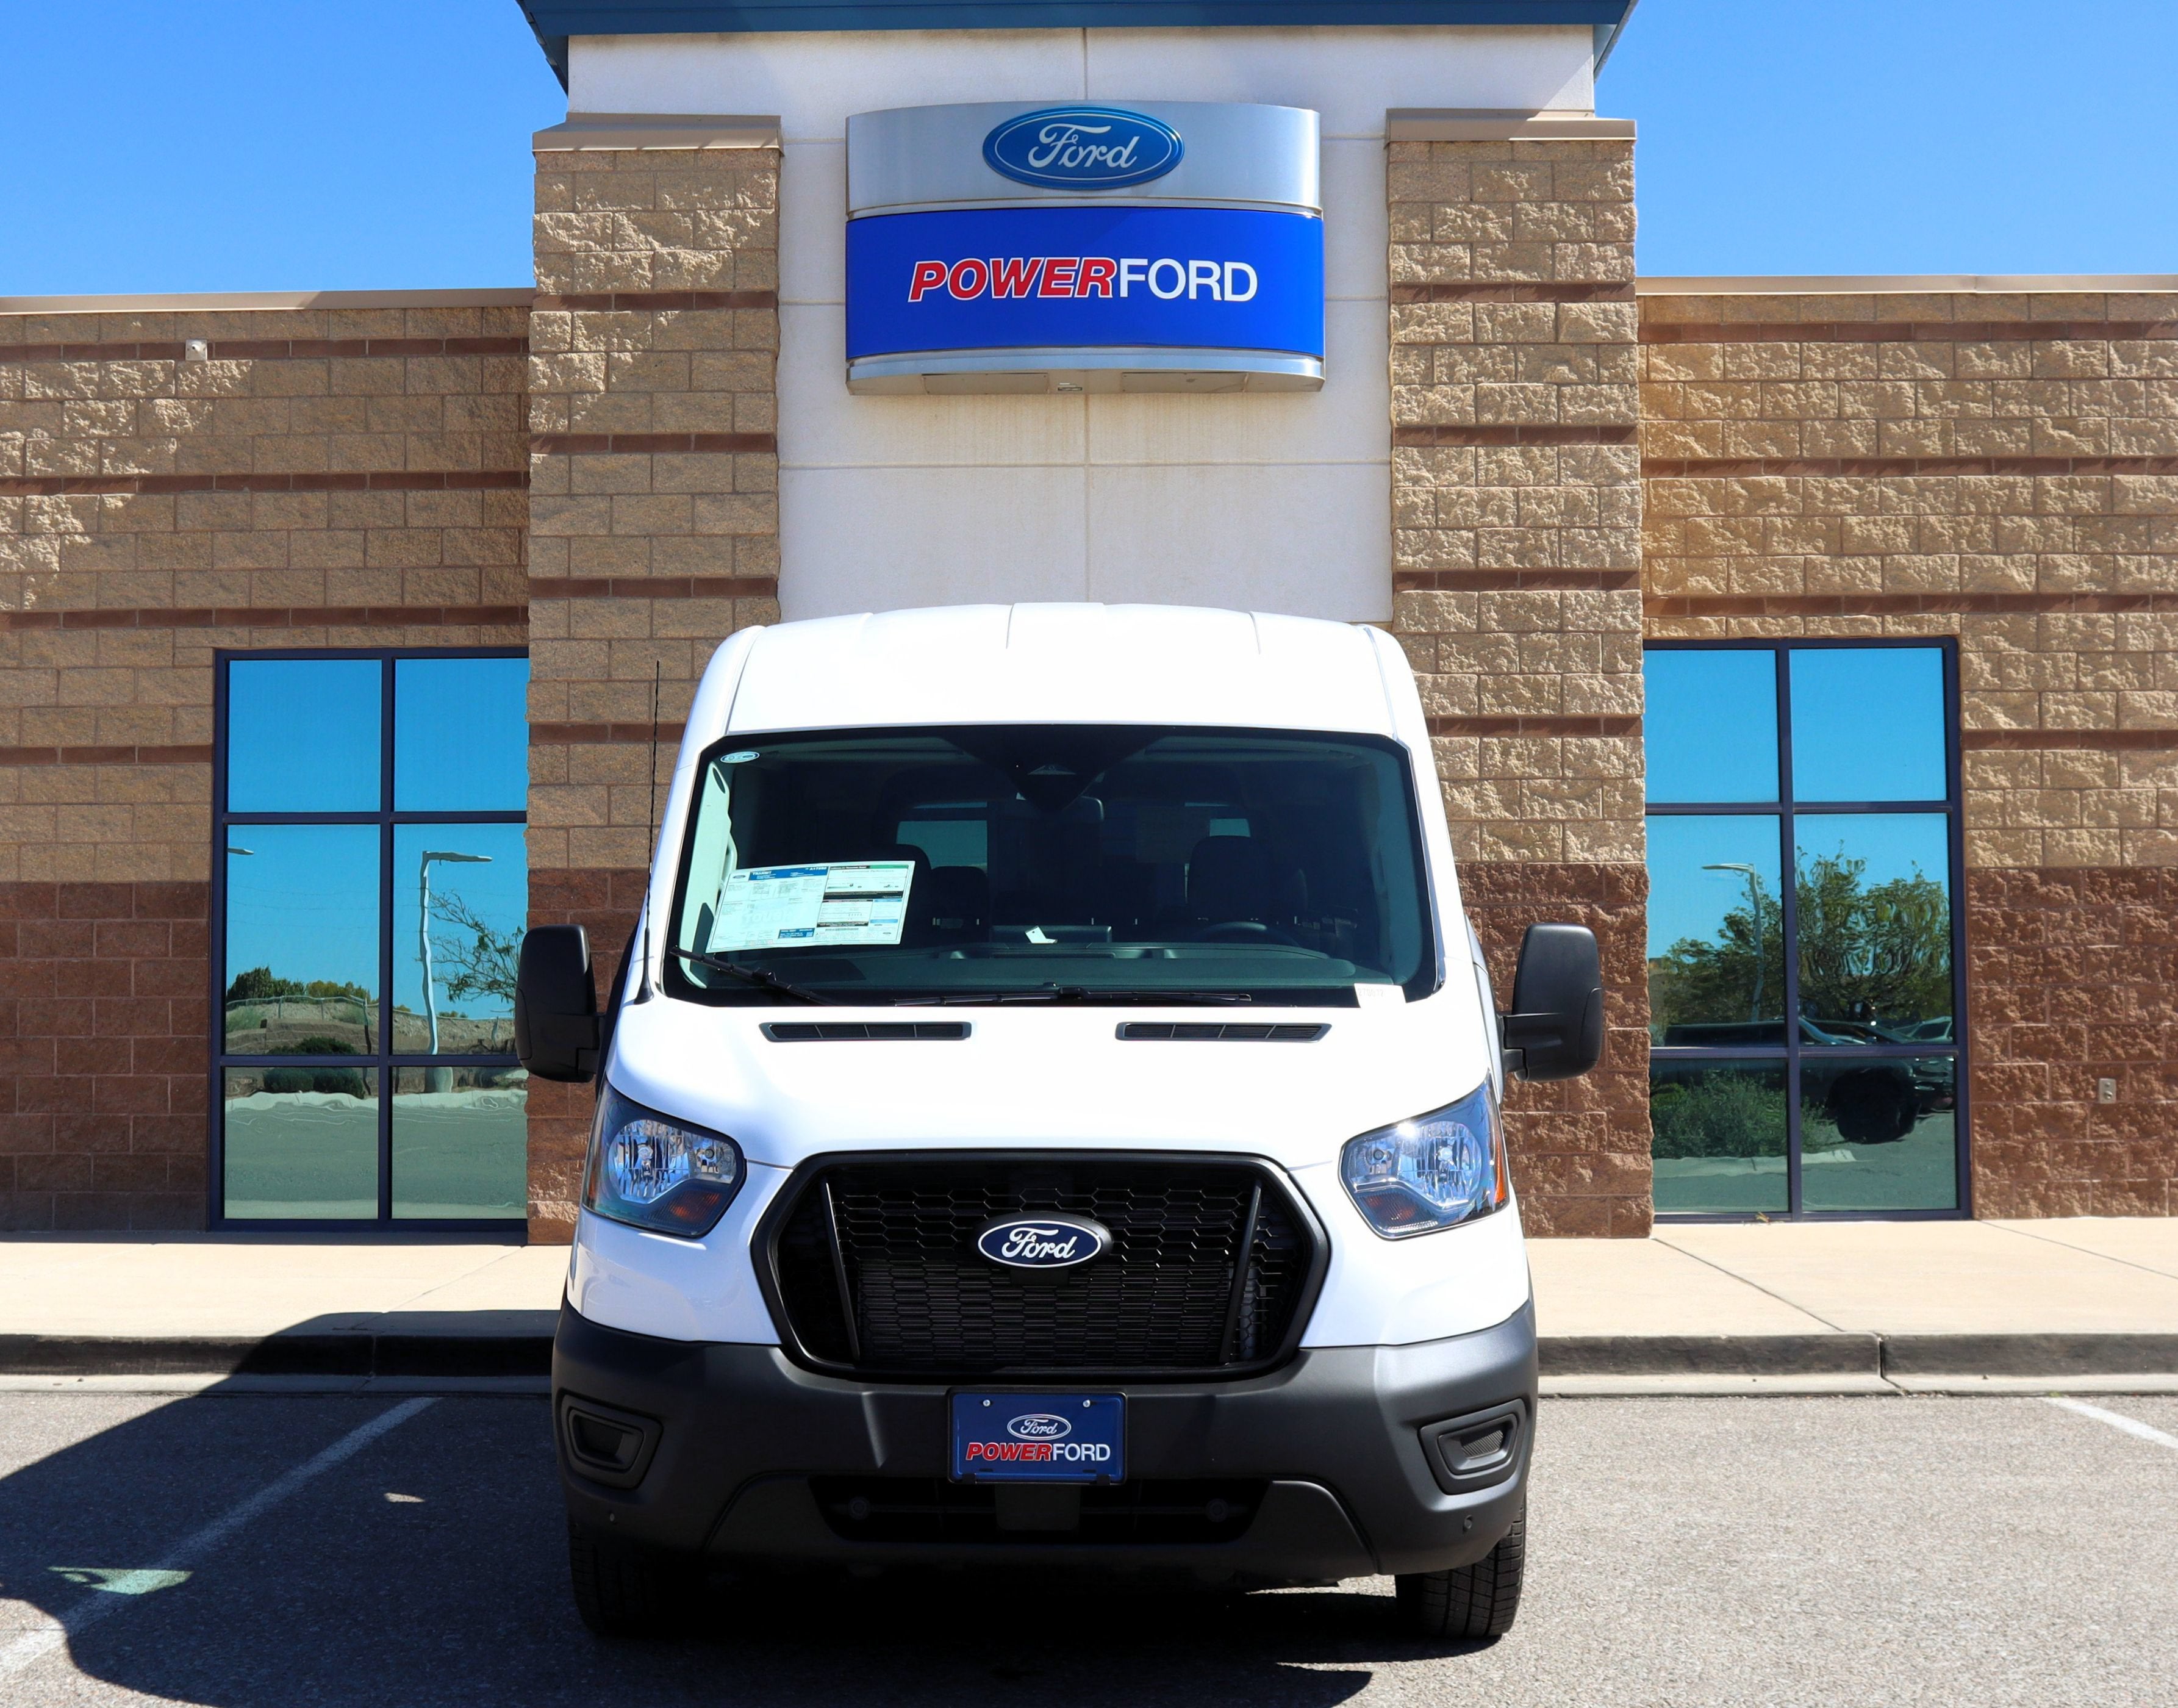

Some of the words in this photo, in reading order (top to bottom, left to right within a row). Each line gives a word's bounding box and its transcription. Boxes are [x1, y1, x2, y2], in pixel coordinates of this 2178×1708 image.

[1028, 123, 1139, 169] Ford
[908, 256, 1258, 303] POWERFORD
[1001, 1227, 1078, 1259] Ford
[1020, 1418, 1058, 1435] Ford
[965, 1442, 1111, 1462] POWERFORD
